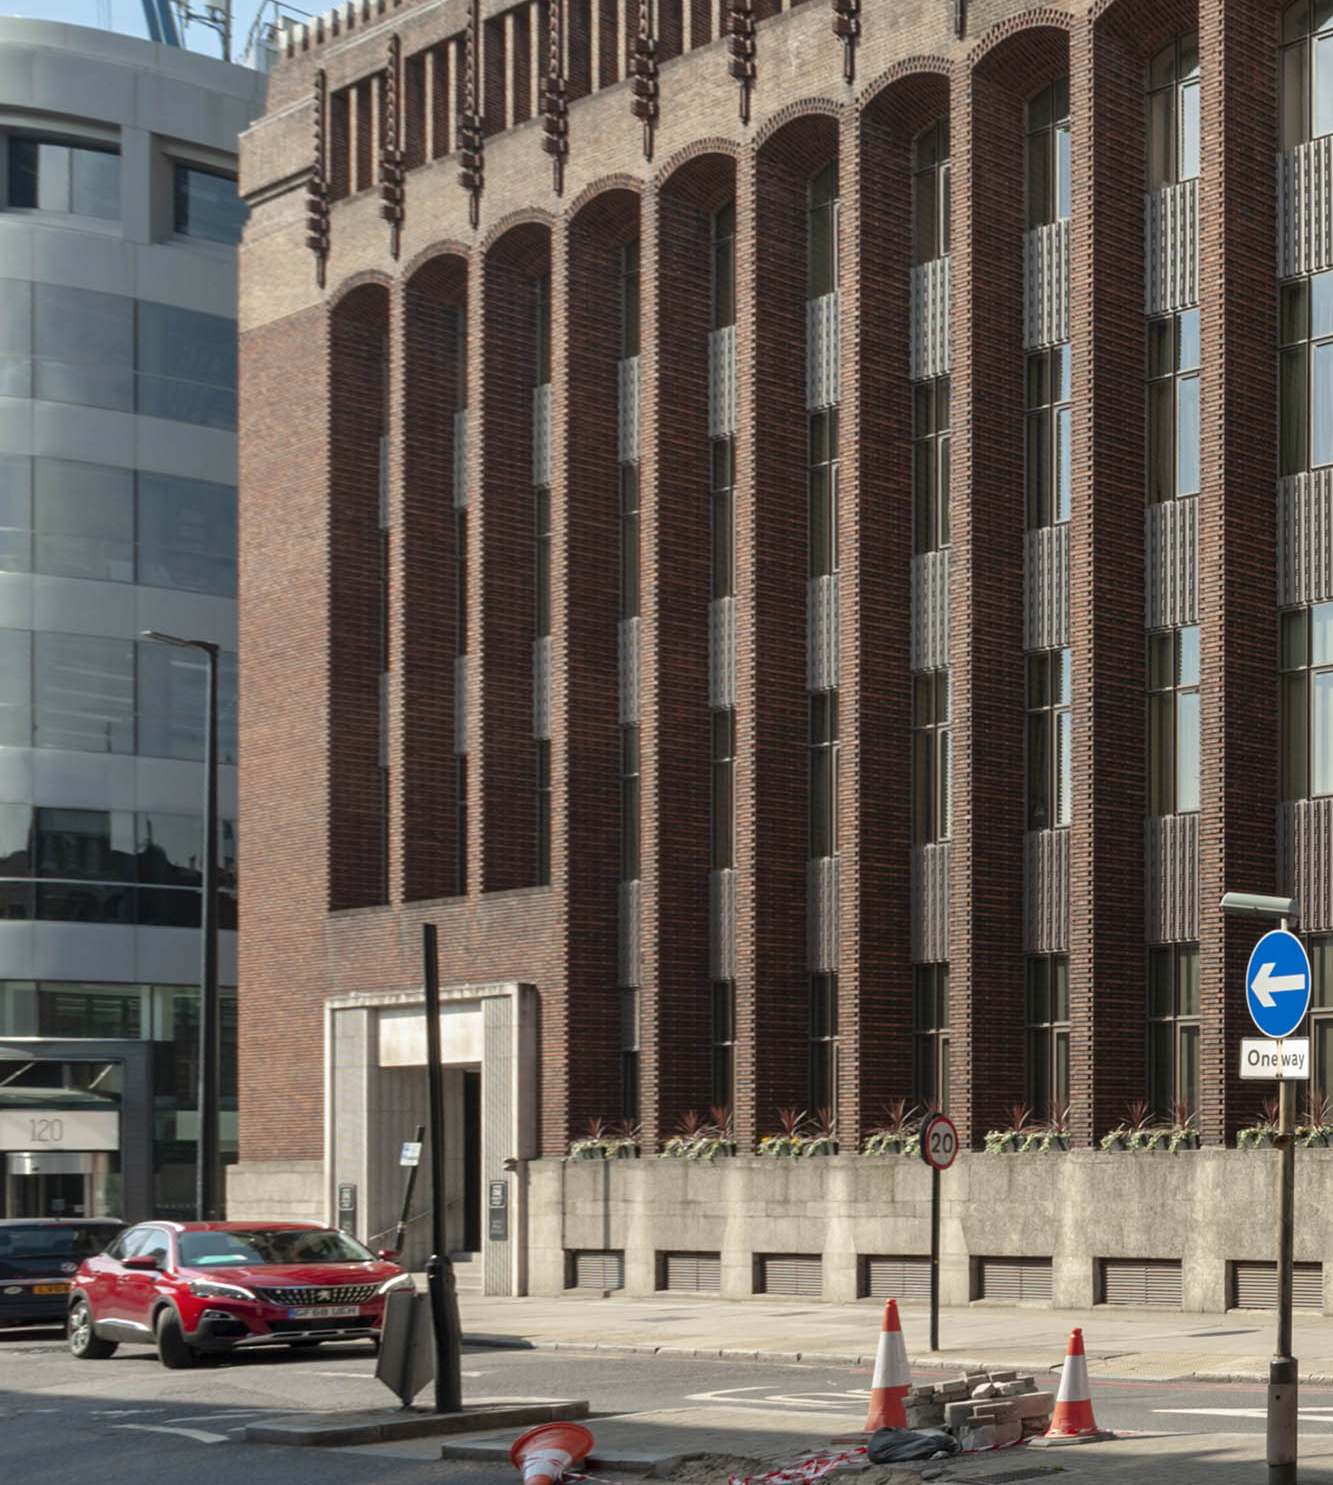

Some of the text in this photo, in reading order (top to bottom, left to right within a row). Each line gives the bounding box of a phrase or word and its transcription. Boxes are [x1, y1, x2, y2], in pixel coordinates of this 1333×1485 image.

[1248, 1049, 1305, 1070] One way
[29, 1118, 63, 1142] 120
[932, 1132, 953, 1153] 20
